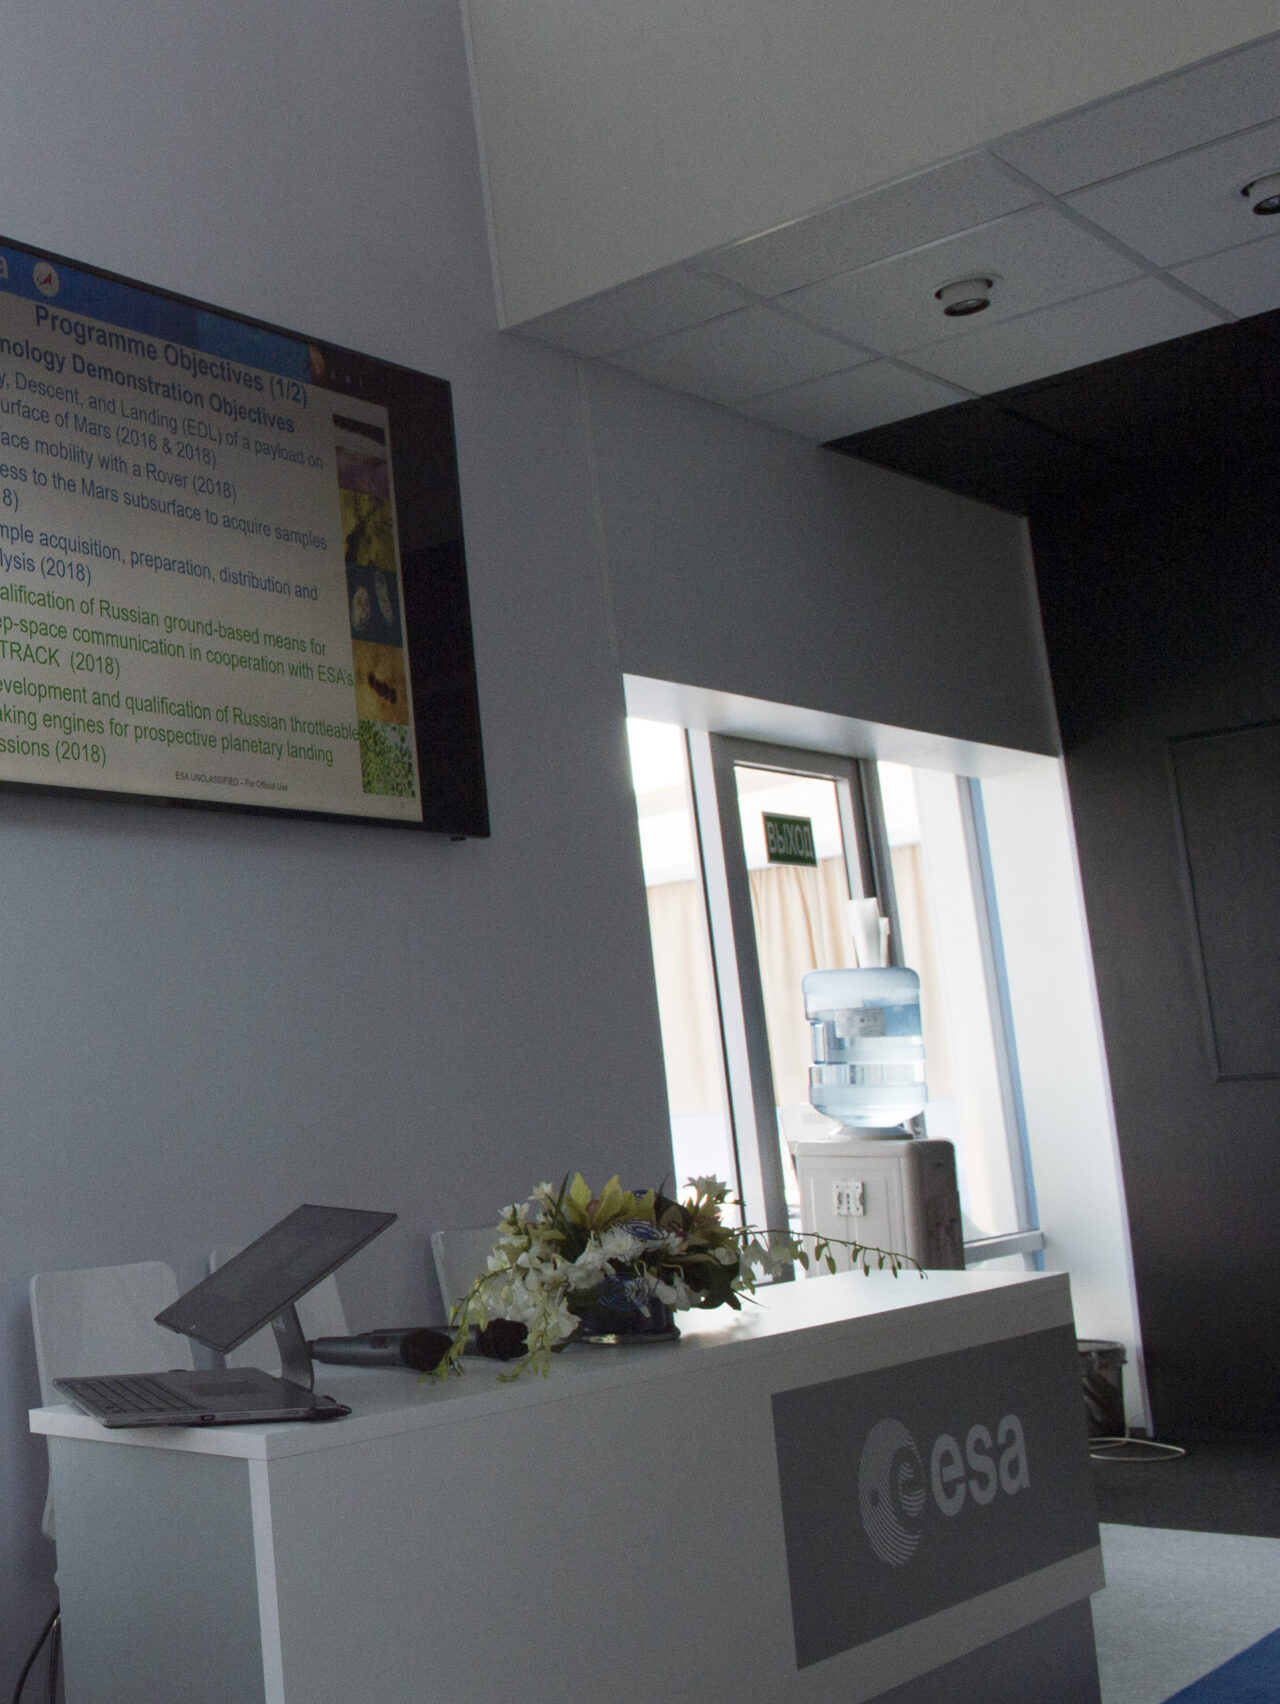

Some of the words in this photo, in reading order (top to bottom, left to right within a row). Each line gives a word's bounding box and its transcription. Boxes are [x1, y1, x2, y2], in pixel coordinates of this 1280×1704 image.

[35, 304, 158, 361] Programme
[163, 343, 264, 393] Objectives
[268, 373, 308, 406] (1/2)
[15, 371, 84, 409] Descent,
[88, 395, 116, 415] and
[120, 399, 178, 435] Landing
[182, 417, 222, 446] (EDL)
[225, 431, 239, 447] of
[242, 437, 251, 452] a
[254, 440, 304, 465] payload
[307, 454, 324, 470] on
[72, 353, 204, 409] Demonstration
[209, 393, 295, 434] Objectives
[54, 411, 70, 429] of
[74, 413, 112, 440] Mars
[116, 425, 158, 452] (2016
[162, 437, 173, 455] &
[176, 441, 216, 468] 2018)
[34, 439, 94, 469] mobility
[98, 454, 128, 474] with
[132, 463, 141, 477] a
[145, 462, 189, 488] Rover
[192, 475, 237, 503] (2018)
[32, 467, 48, 487] to
[52, 471, 76, 493] the
[81, 477, 119, 503] Mars
[123, 491, 201, 522] subsurface
[205, 508, 219, 526] to
[222, 514, 271, 537] acquire
[274, 527, 327, 550] samples
[39, 532, 125, 565] acquisition,
[130, 551, 215, 583] preparation,
[219, 566, 291, 596] distribution
[295, 585, 318, 601] and
[40, 556, 92, 587] (2018)
[72, 627, 185, 659] communication
[189, 642, 202, 661] in
[205, 650, 285, 675] cooperation
[288, 661, 314, 680] with
[79, 597, 95, 616] of
[99, 599, 160, 627] Russian
[163, 615, 260, 645] ground-based
[263, 633, 307, 653] means
[310, 638, 326, 656] for
[70, 651, 120, 679] (2018)
[42, 712, 105, 736] engines
[108, 717, 130, 738] for
[133, 724, 217, 749] prospective
[221, 733, 283, 761] planetary
[286, 741, 333, 767] landing
[91, 690, 121, 709] and
[124, 695, 211, 721] qualification
[215, 705, 229, 723] of
[232, 706, 287, 731] Russian
[290, 716, 360, 741] throttleable
[55, 740, 107, 767] (2018)
[766, 822, 813, 858] ВЫХОД
[931, 1414, 1030, 1516] esa
